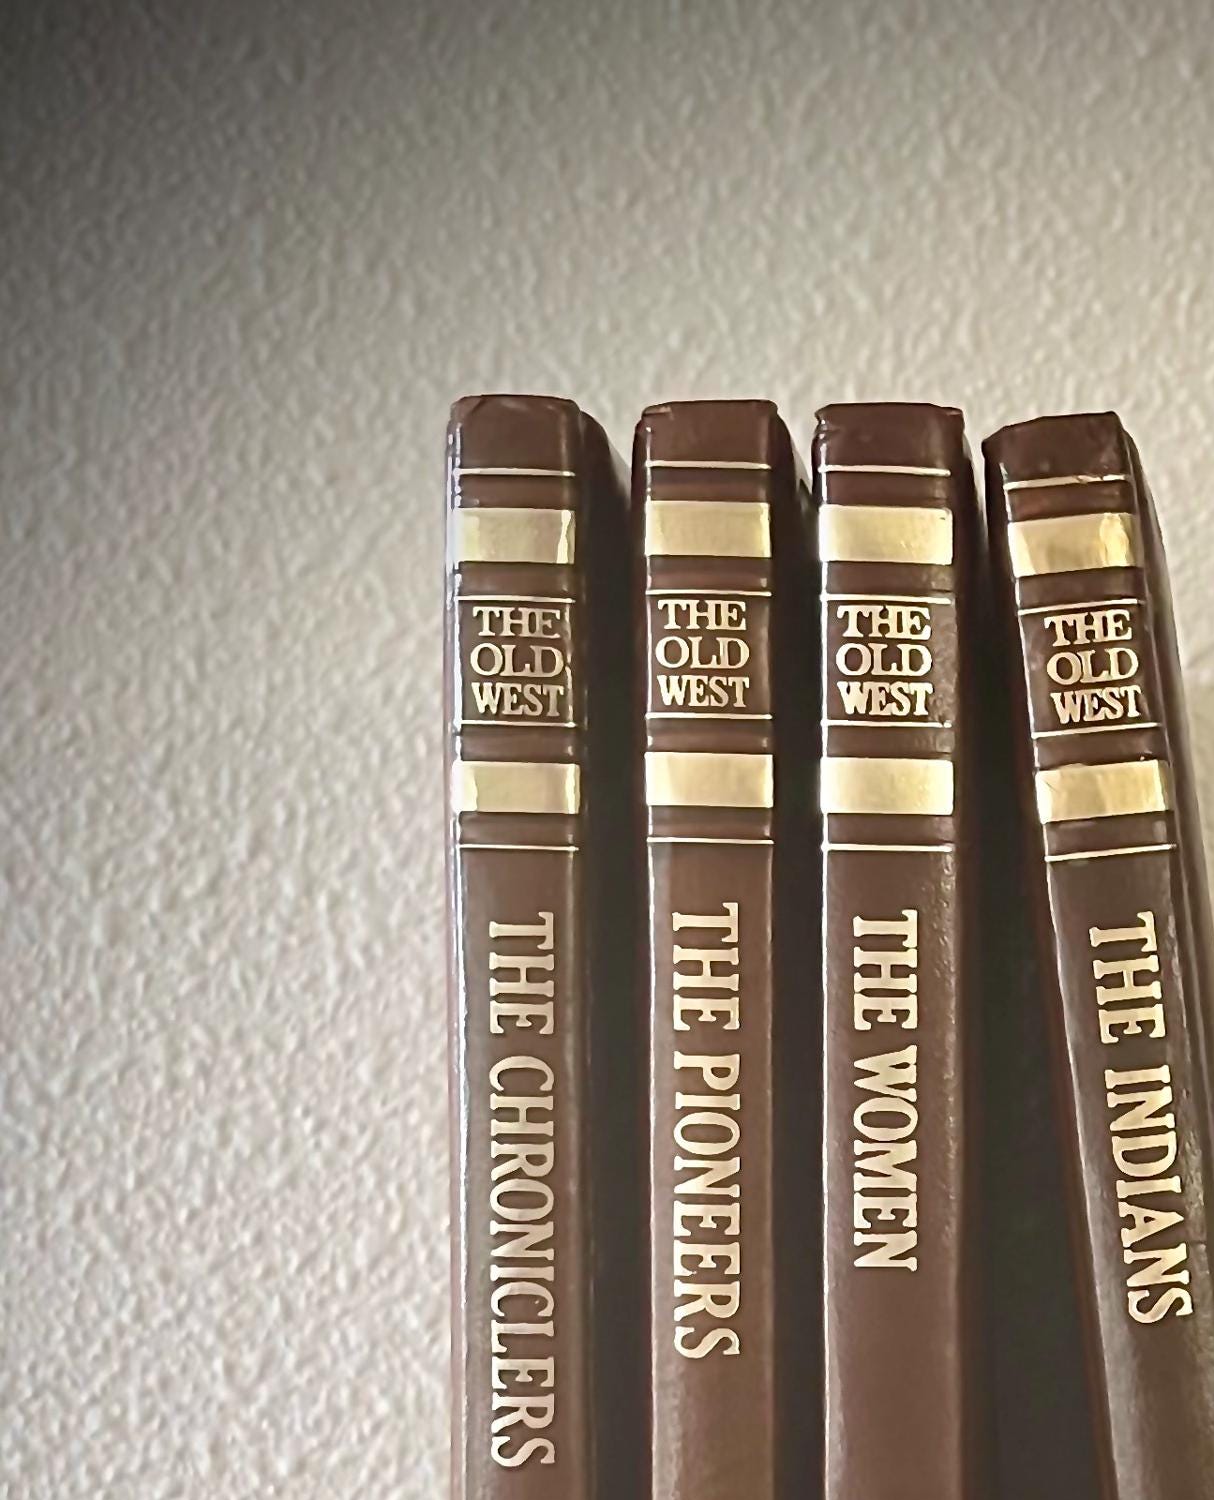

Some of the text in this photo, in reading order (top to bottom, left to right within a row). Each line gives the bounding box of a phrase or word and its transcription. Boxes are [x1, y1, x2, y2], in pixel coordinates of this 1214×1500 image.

[472, 608, 561, 639] THE
[658, 599, 747, 631] THE
[837, 605, 931, 640] THE
[1044, 609, 1133, 647] THE
[470, 643, 564, 678] OLD
[655, 636, 750, 670] OLD
[835, 643, 933, 677] OLD
[1046, 648, 1139, 686] OLD
[471, 682, 565, 717] WEST
[656, 674, 750, 708] WEST
[836, 681, 933, 717] WEST
[1050, 685, 1143, 724] WEST
[852, 909, 919, 1272] THE WOMEN
[672, 902, 741, 1359] THE PIONEERS
[1089, 911, 1194, 1324] THE INDIANS
[488, 911, 556, 1468] THE CHRONICLERS
